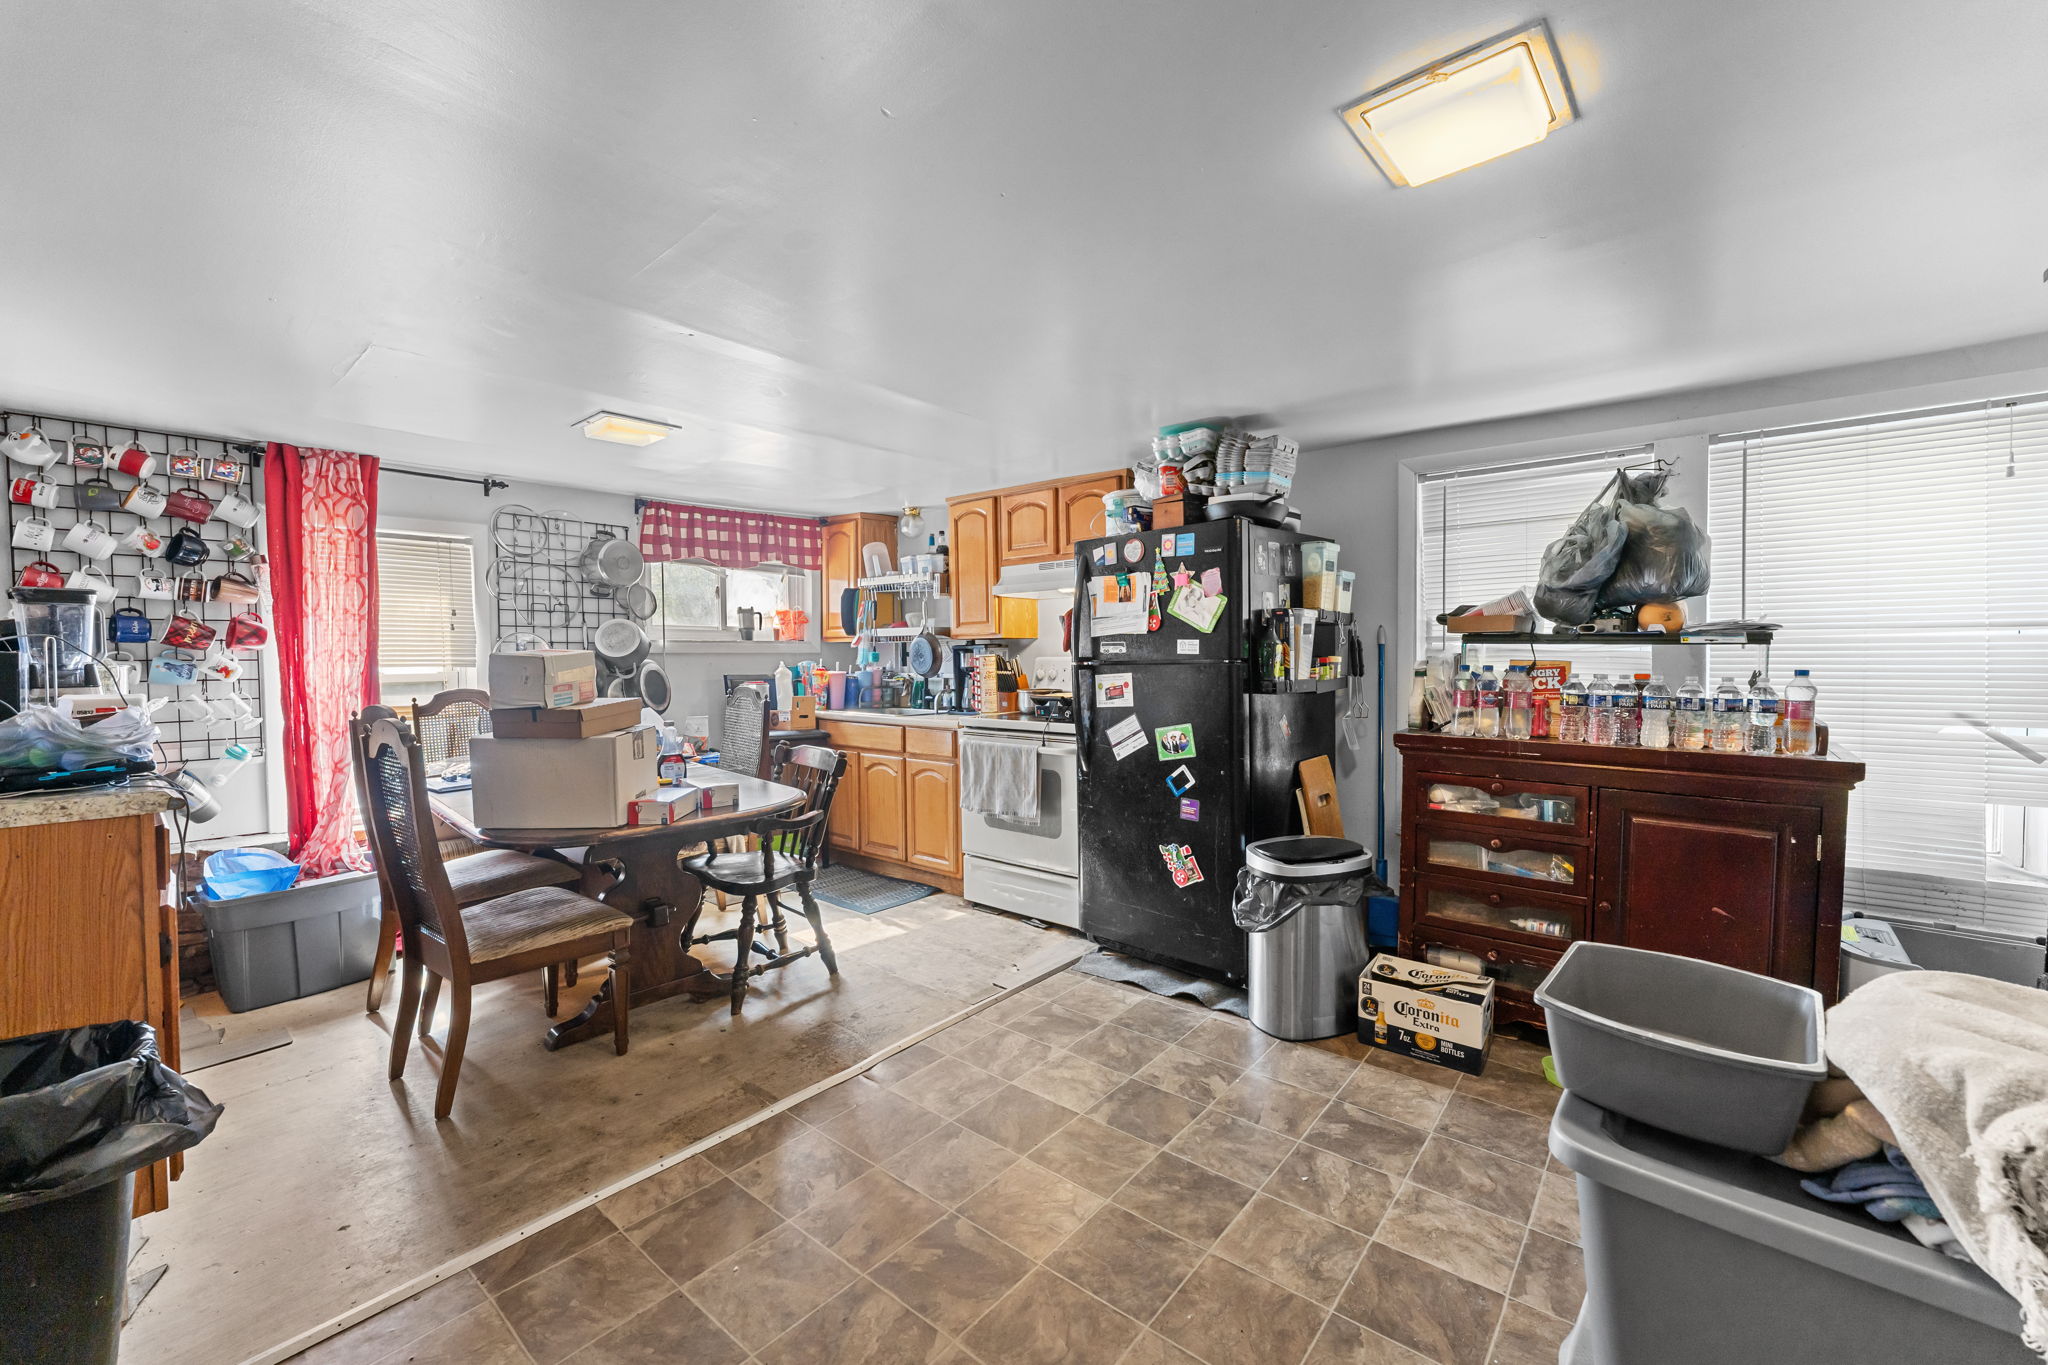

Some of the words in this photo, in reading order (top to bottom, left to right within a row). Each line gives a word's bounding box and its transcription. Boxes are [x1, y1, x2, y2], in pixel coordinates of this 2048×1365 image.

[1530, 669, 1560, 677] NGRY
[1533, 677, 1561, 689] CK
[1363, 982, 1370, 990] 24
[1394, 1000, 1460, 1028] Coronita
[1413, 1017, 1440, 1032] Extra
[1441, 1040, 1453, 1049] MINI
[1441, 1047, 1465, 1059] BOTTLES
